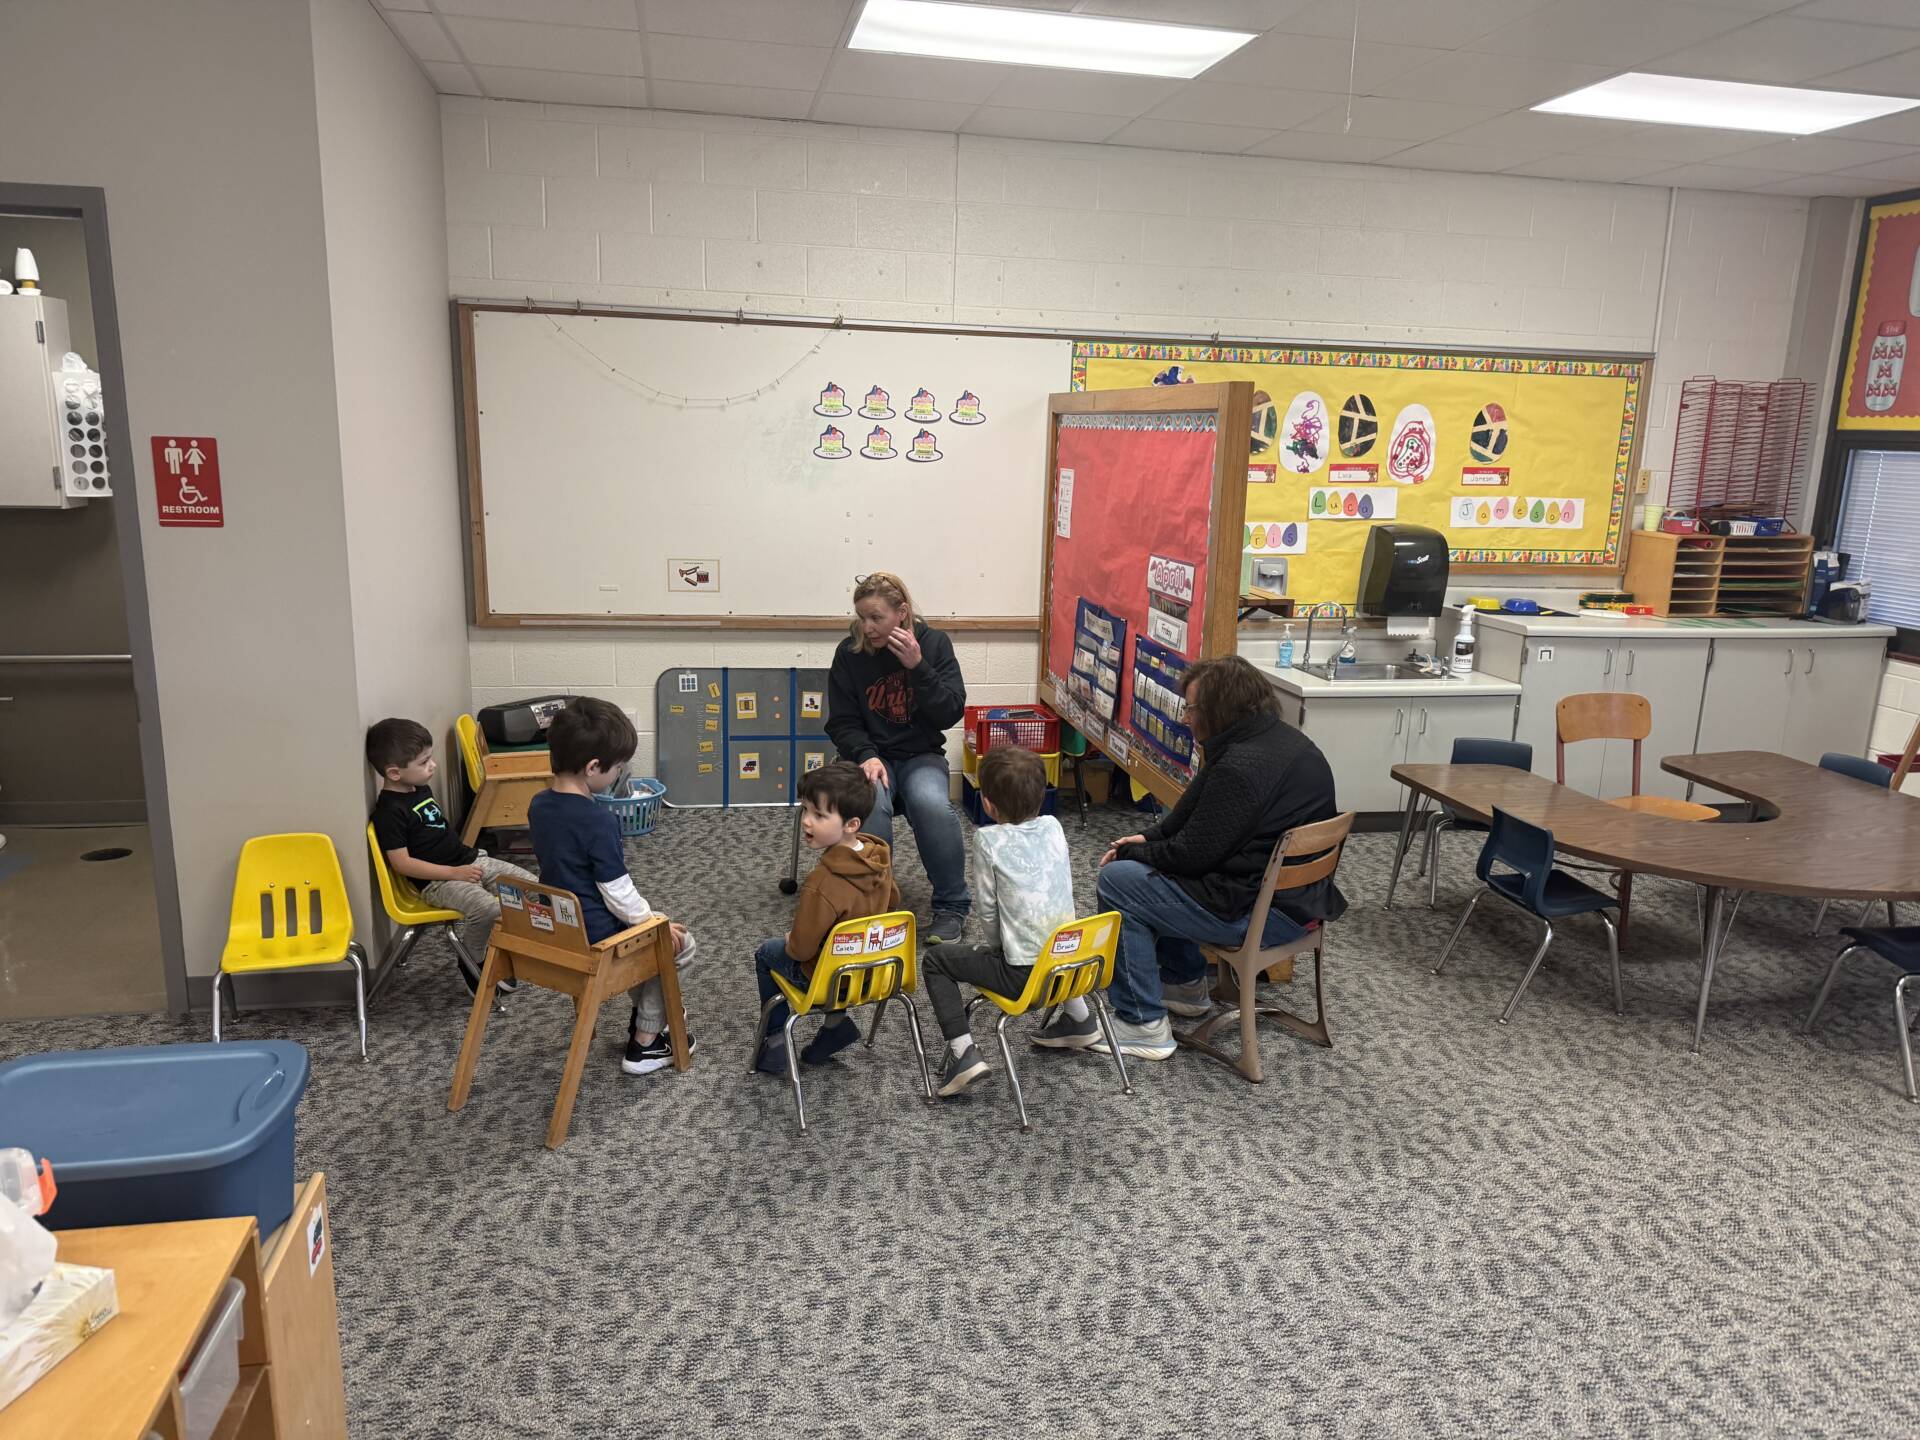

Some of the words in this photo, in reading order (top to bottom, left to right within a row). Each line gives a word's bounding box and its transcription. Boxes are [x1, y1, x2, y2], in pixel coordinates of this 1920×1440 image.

[162, 505, 219, 514] RESTROOM
[1313, 496, 1369, 514] Luca
[1462, 501, 1571, 521] Jameson
[1155, 562, 1185, 593] April
[884, 926, 898, 937] Hello
[835, 935, 850, 944] Hello
